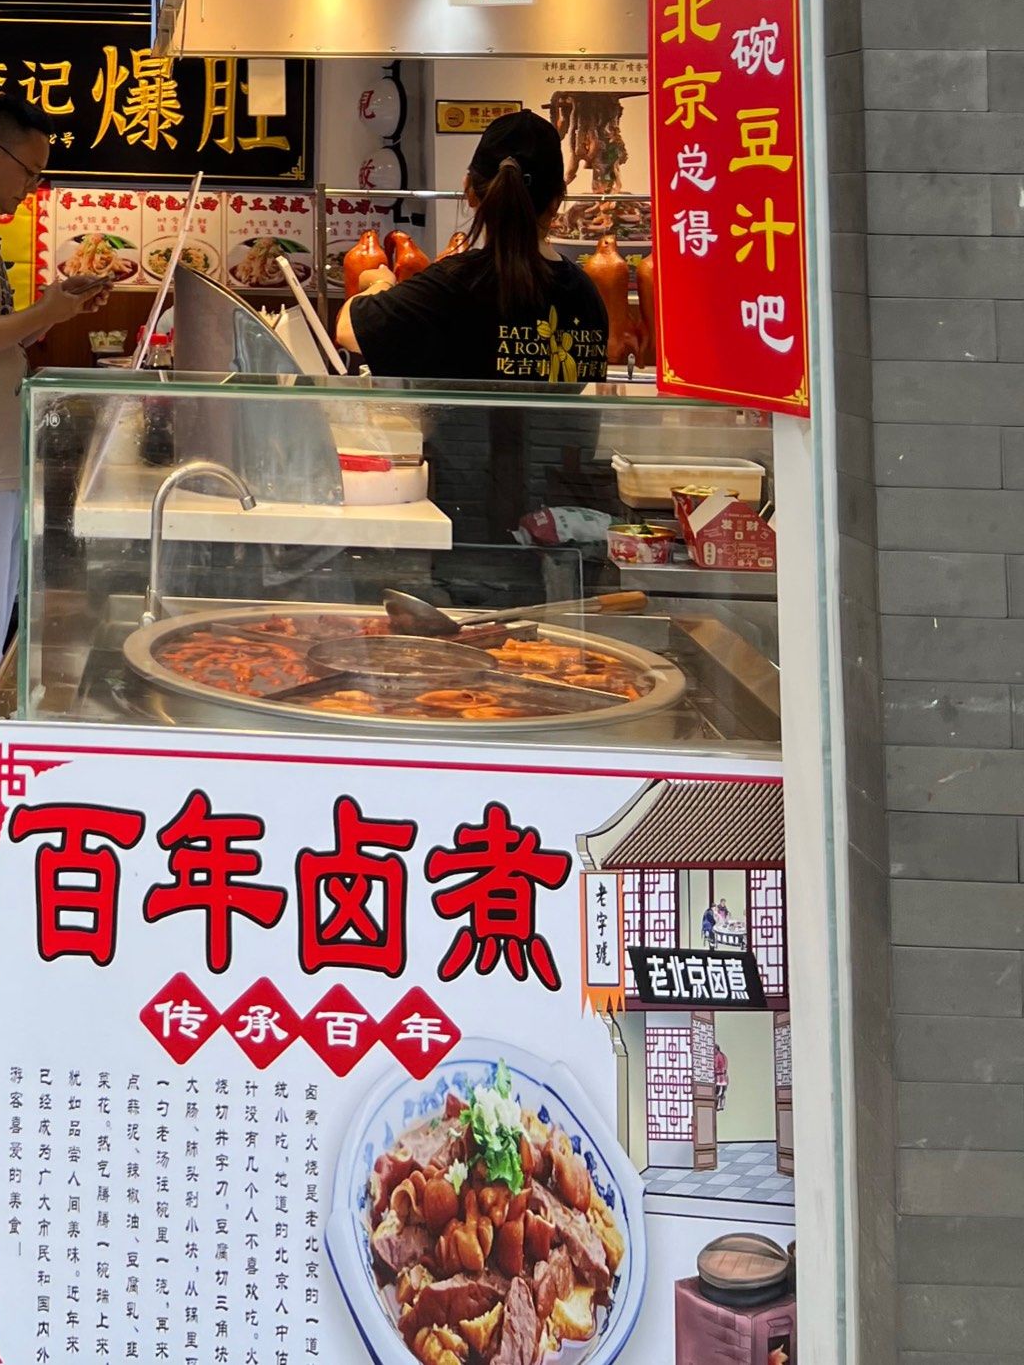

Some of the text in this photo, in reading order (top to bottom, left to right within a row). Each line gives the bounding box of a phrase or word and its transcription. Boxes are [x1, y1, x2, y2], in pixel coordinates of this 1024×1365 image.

[498, 340, 509, 354] A
[499, 325, 532, 340] EAT
[9, 788, 573, 991] 百年卤煮
[646, 953, 750, 1001] 老北京卤煮
[160, 997, 452, 1053] 传承百年
[305, 1084, 320, 1365] 卤煮火烧是老北京的一道
